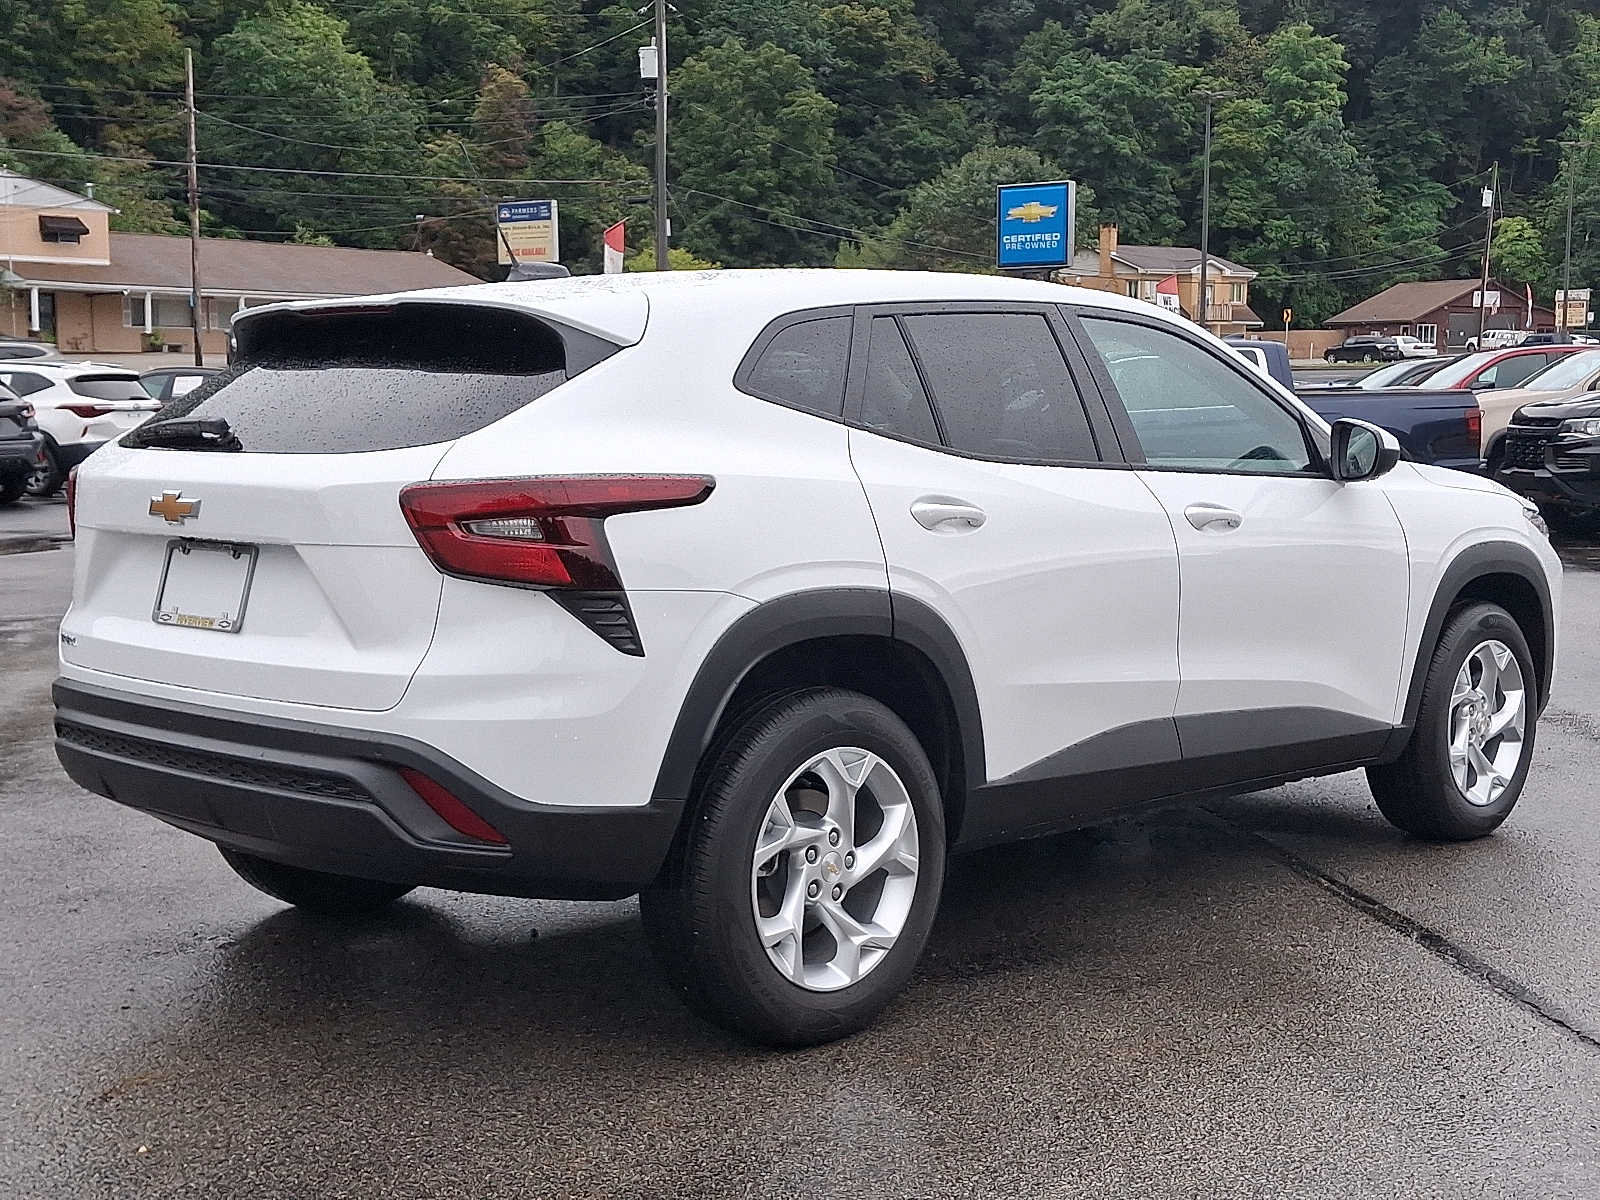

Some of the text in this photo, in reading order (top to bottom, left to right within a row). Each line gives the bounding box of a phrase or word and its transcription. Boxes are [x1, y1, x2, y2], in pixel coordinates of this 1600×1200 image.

[1003, 232, 1060, 243] CERTIFIED
[1005, 240, 1058, 250] PRE-OWNED
[521, 247, 546, 256] AVAILABLE
[1162, 296, 1172, 306] WE
